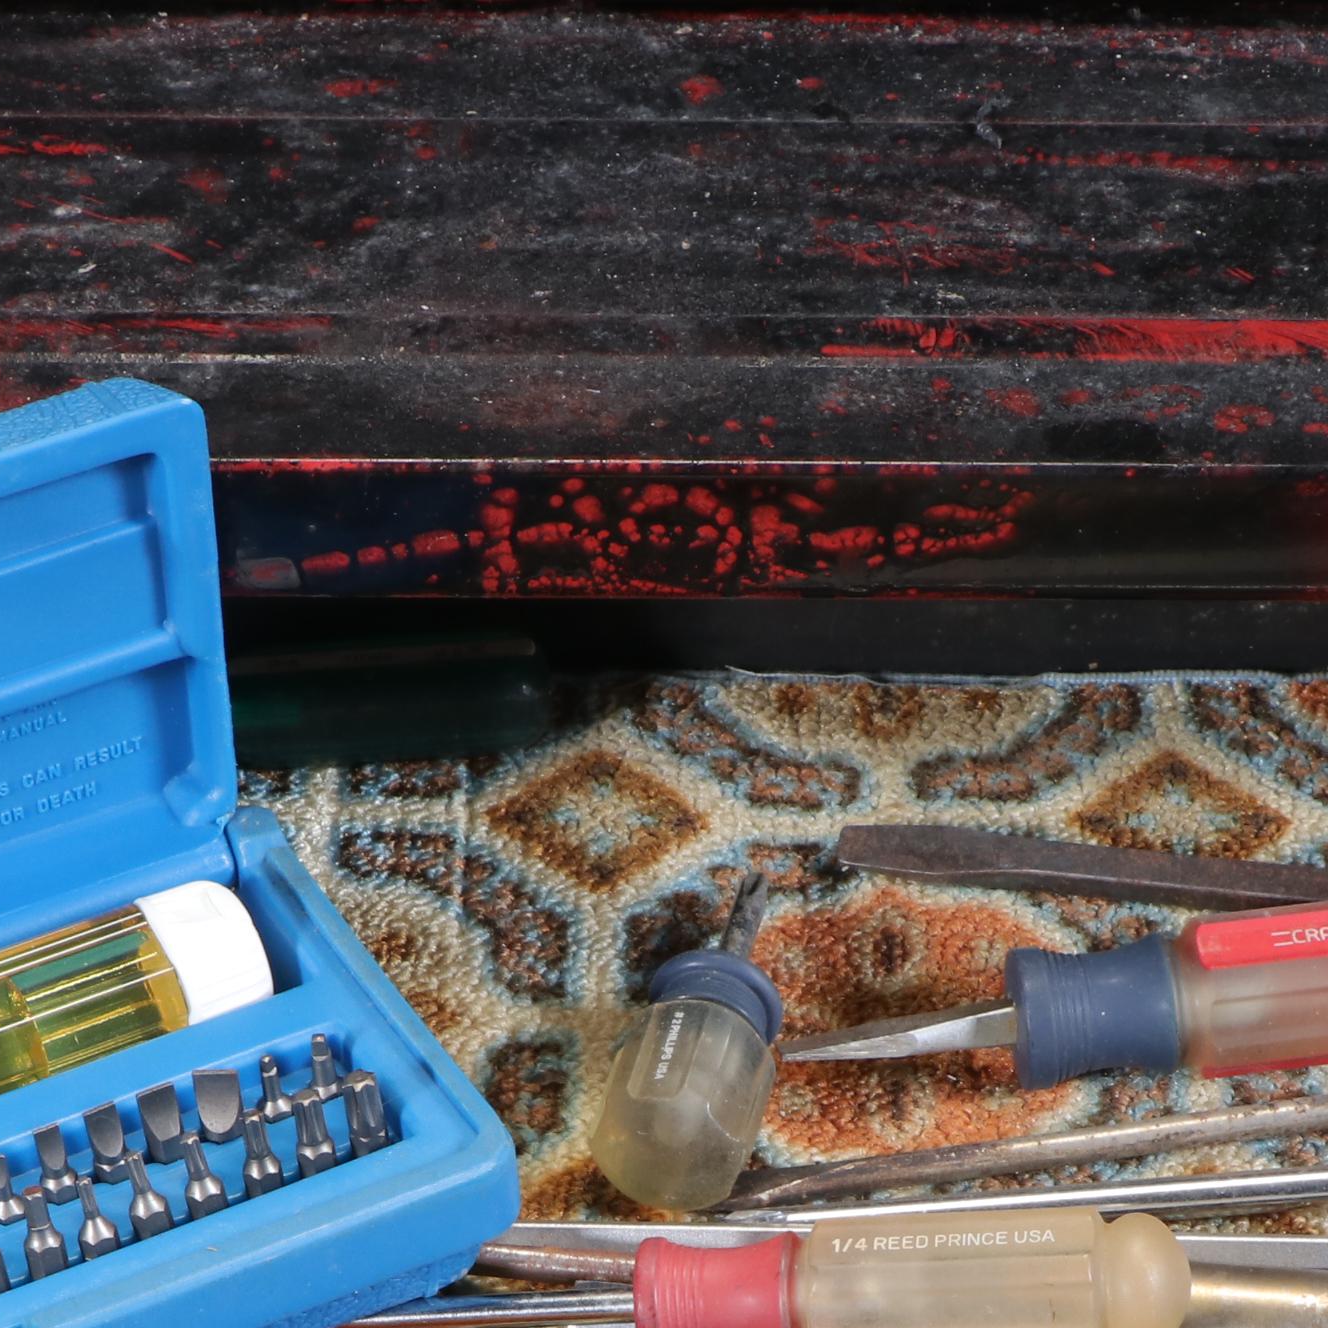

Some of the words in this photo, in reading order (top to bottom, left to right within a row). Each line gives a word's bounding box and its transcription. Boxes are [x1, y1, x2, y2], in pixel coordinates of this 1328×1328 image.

[22, 763, 62, 789] CAN
[74, 736, 143, 772] RESULT
[0, 807, 25, 826] OR
[37, 781, 97, 814] DEATH
[654, 1062, 670, 1080] USA
[831, 1237, 869, 1253] 1/4
[873, 1235, 929, 1251] REED
[934, 1231, 1009, 1248] PRINCE
[1014, 1229, 1056, 1245] USA
